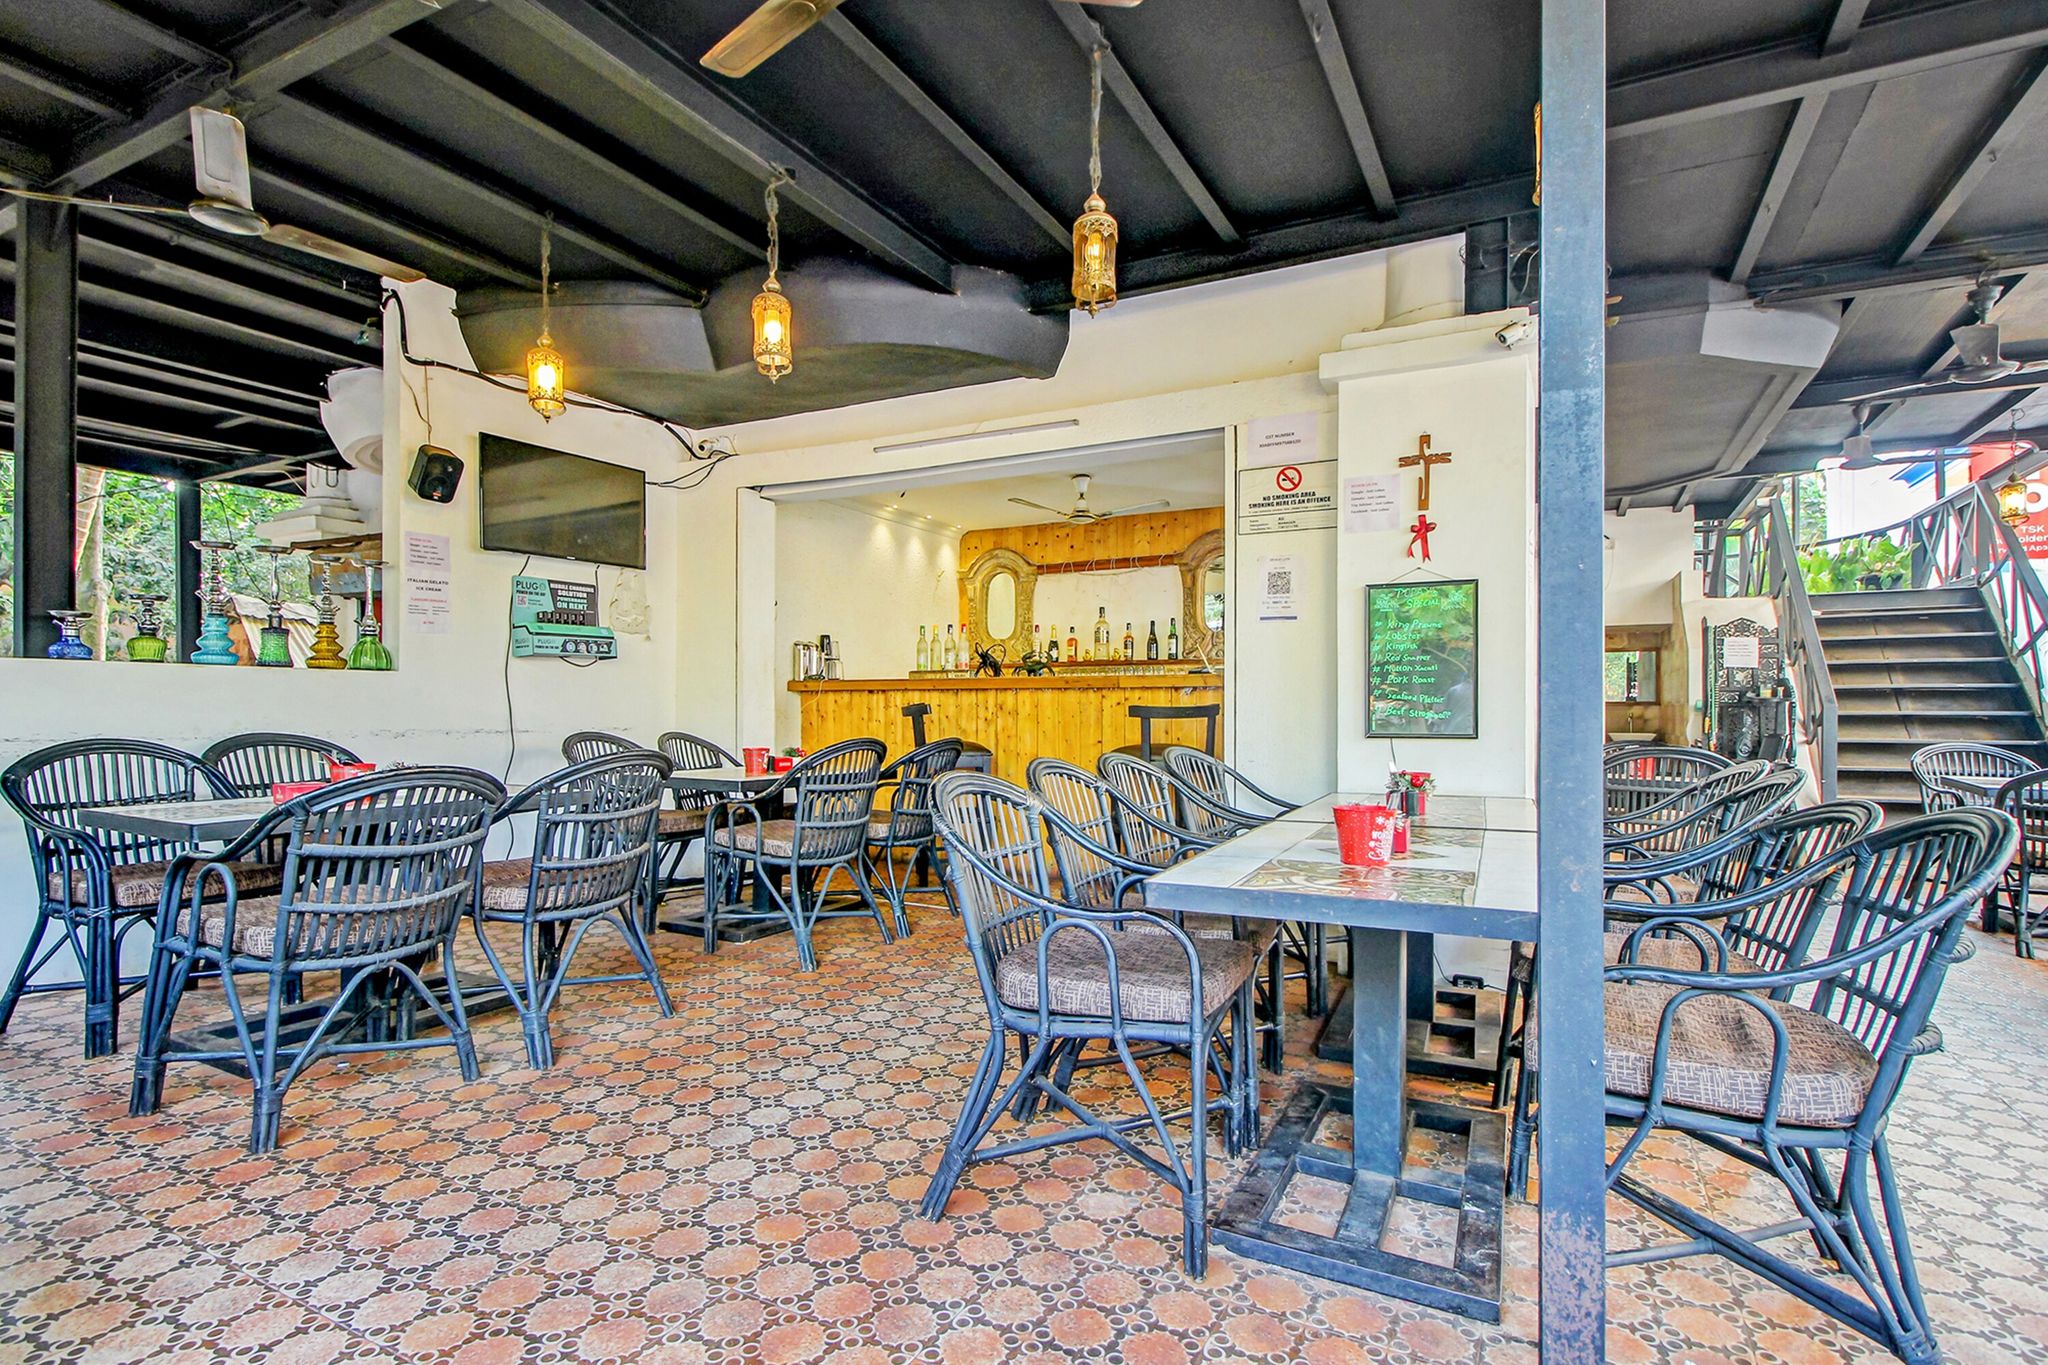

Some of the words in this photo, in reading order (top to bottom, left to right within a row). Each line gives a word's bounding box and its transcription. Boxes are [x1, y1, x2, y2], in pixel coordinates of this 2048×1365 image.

[1272, 492, 1299, 500] SMOKING
[1248, 501, 1275, 509] SMOKING
[1306, 496, 1331, 504] OFFENCE
[2021, 525, 2045, 533] TSK
[2018, 535, 2048, 543] older
[569, 584, 594, 593] CHARGING
[557, 590, 587, 598] SOLUTION
[568, 602, 588, 610] RENT
[1387, 675, 1409, 684] Pork
[1411, 675, 1436, 684] Roast
